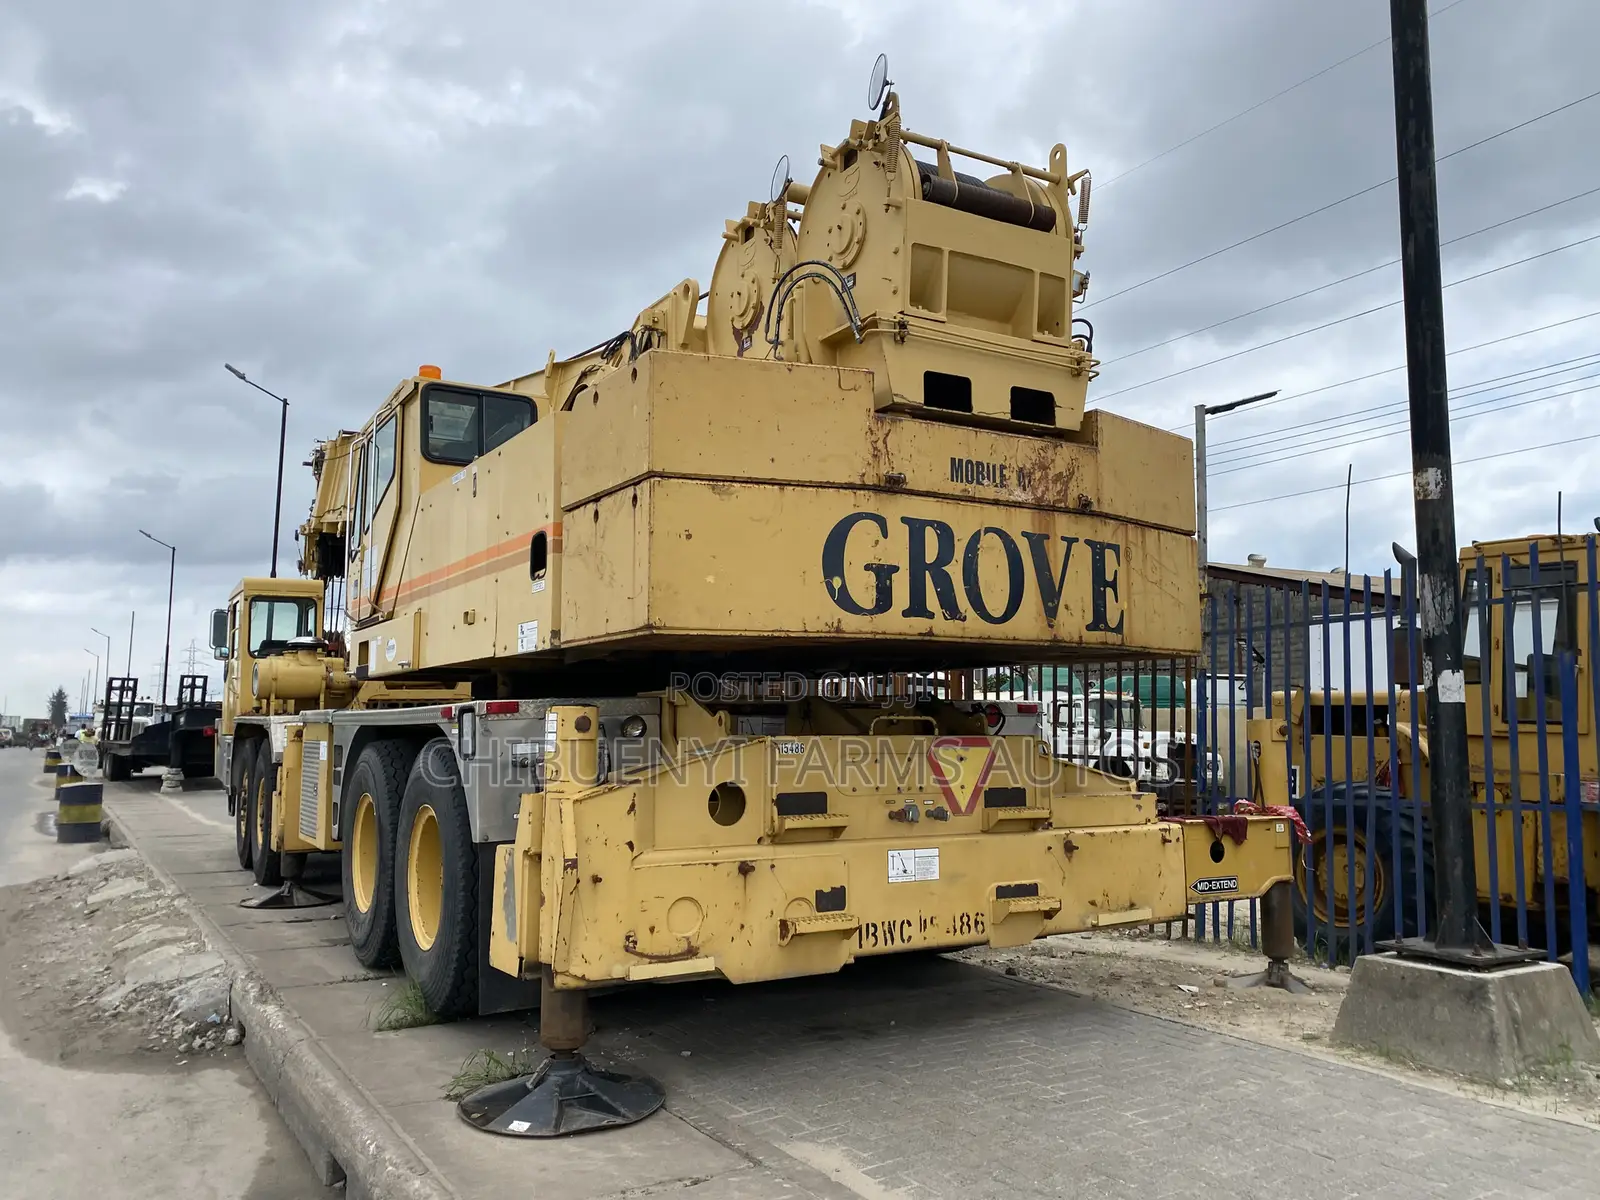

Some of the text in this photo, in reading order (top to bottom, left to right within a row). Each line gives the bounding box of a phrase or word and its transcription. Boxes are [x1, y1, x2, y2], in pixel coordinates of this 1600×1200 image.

[950, 457, 1007, 489] MOBILE
[821, 511, 1124, 636] GROVE
[1197, 879, 1238, 891] MID-EXTEND
